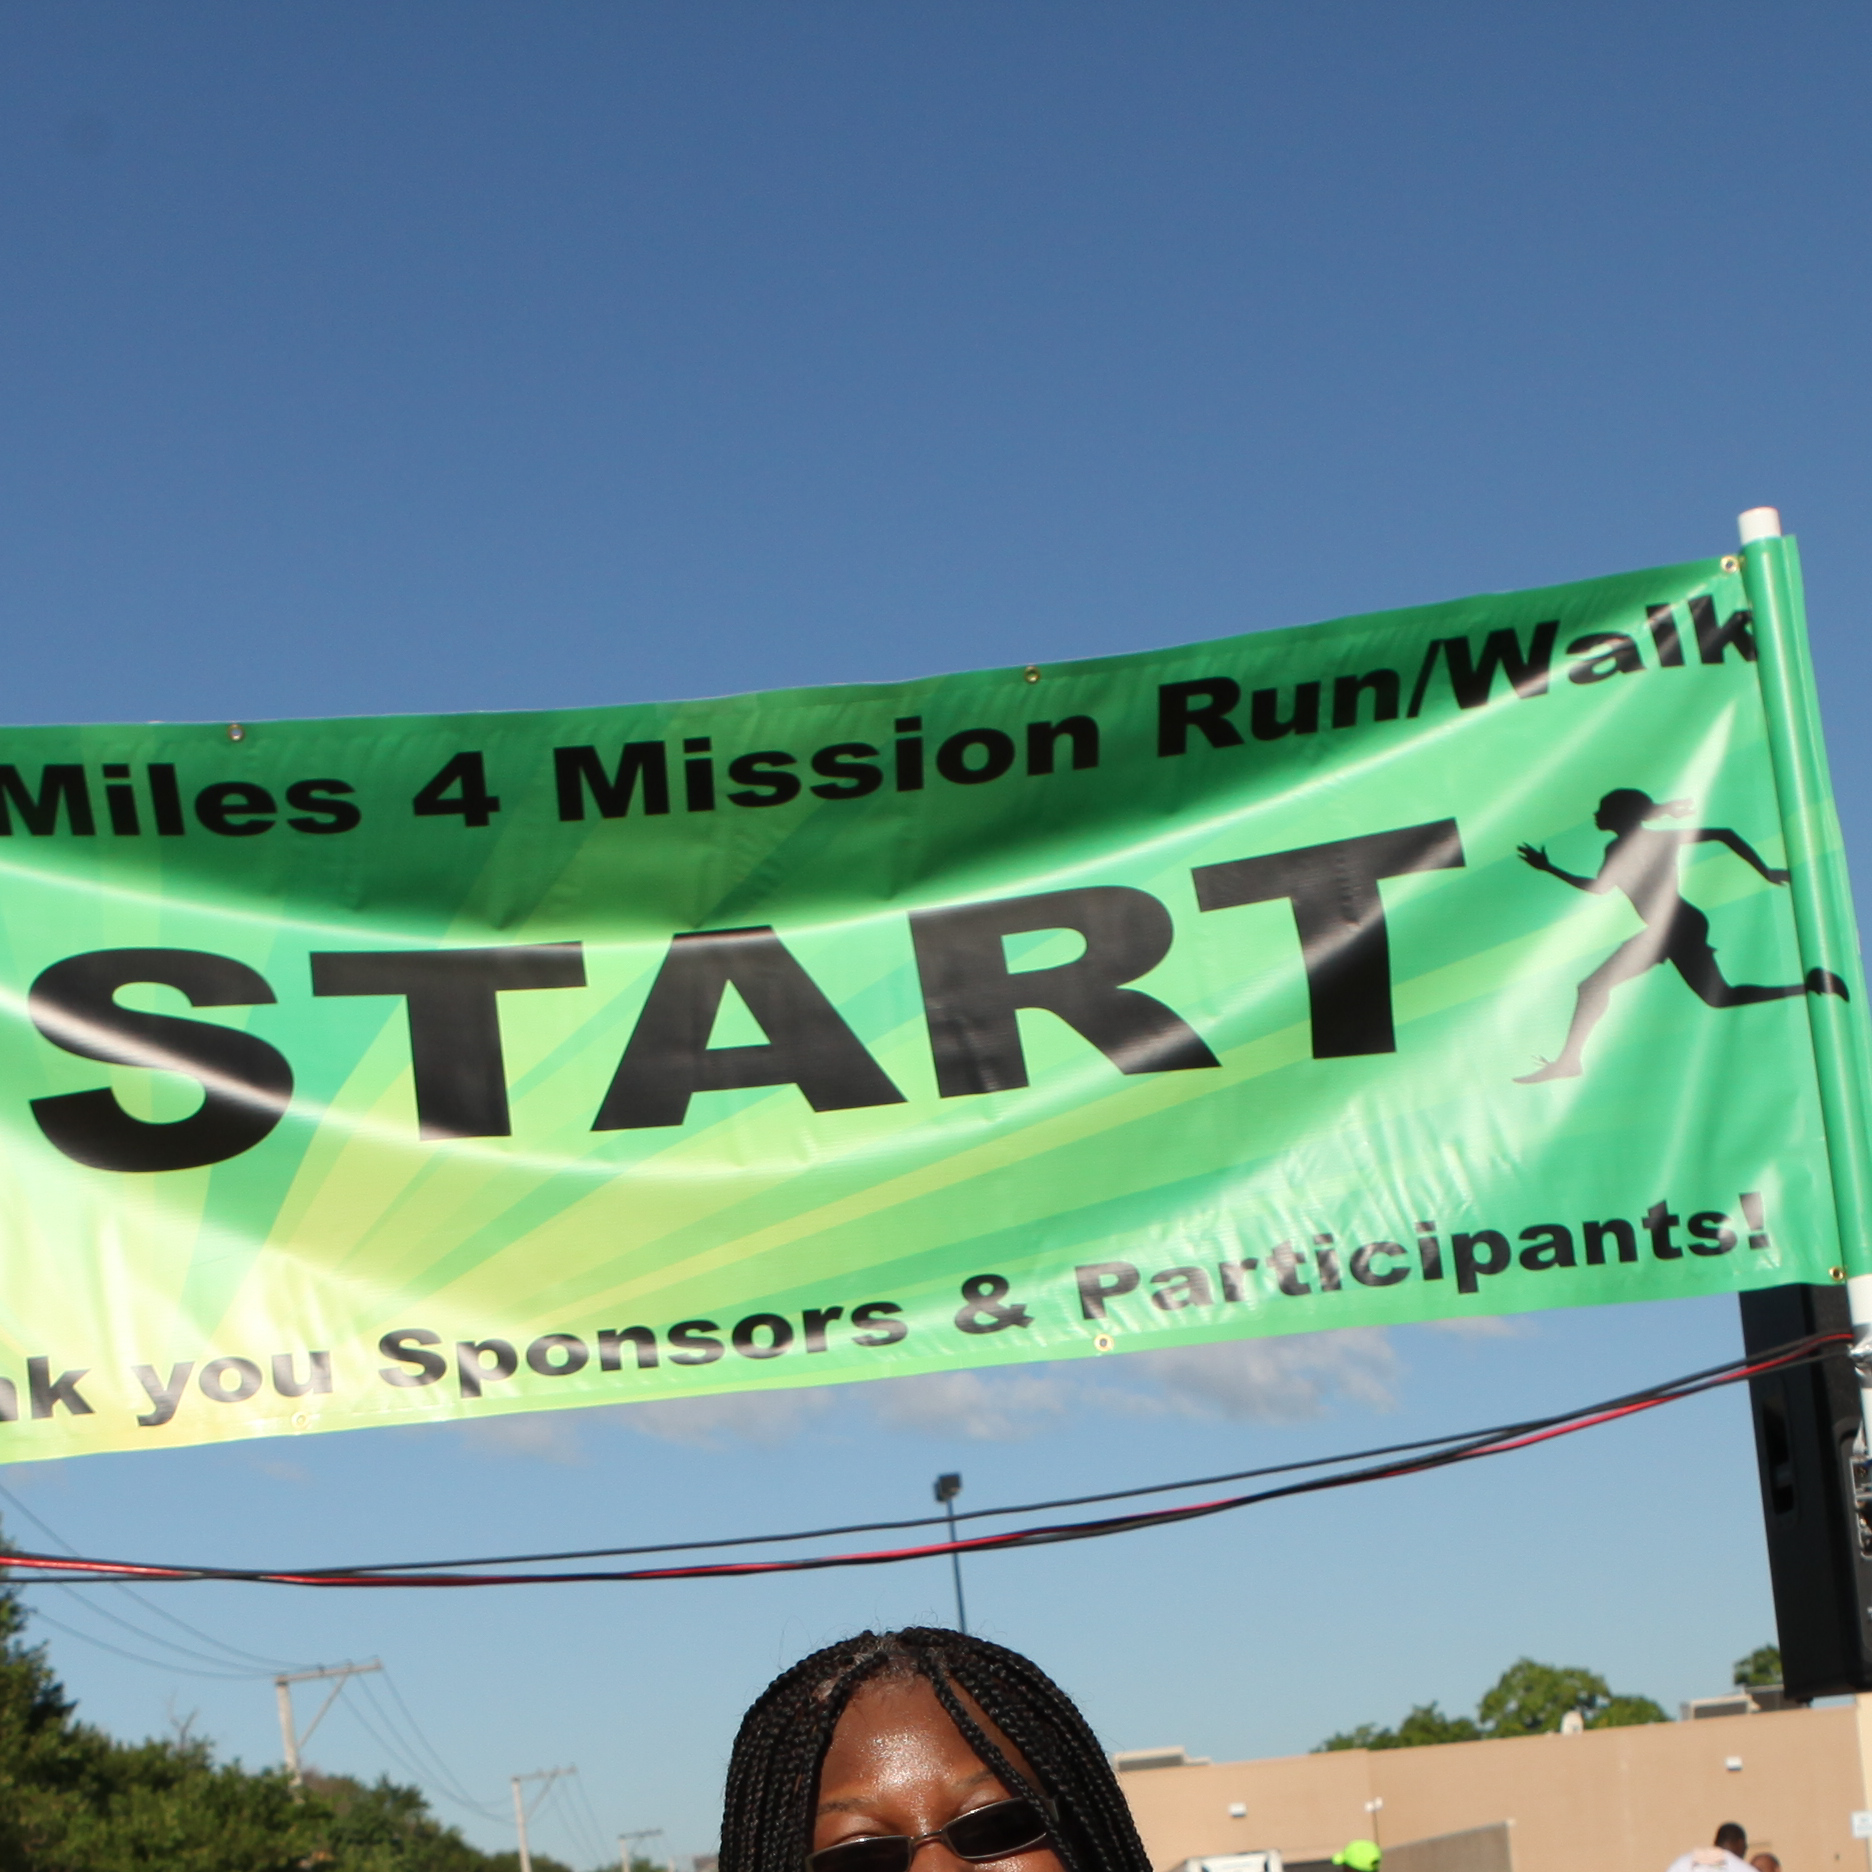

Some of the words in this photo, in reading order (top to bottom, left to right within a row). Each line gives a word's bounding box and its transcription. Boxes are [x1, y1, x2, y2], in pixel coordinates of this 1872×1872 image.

[412, 751, 501, 828] 4
[552, 713, 1101, 822] Mission
[1156, 594, 1758, 756] Run/Walk
[26, 817, 1466, 1174] START
[127, 1350, 334, 1427] you
[377, 1299, 909, 1398] Sponsors
[952, 1273, 1035, 1336] &
[1074, 1193, 1769, 1320] Participants!
